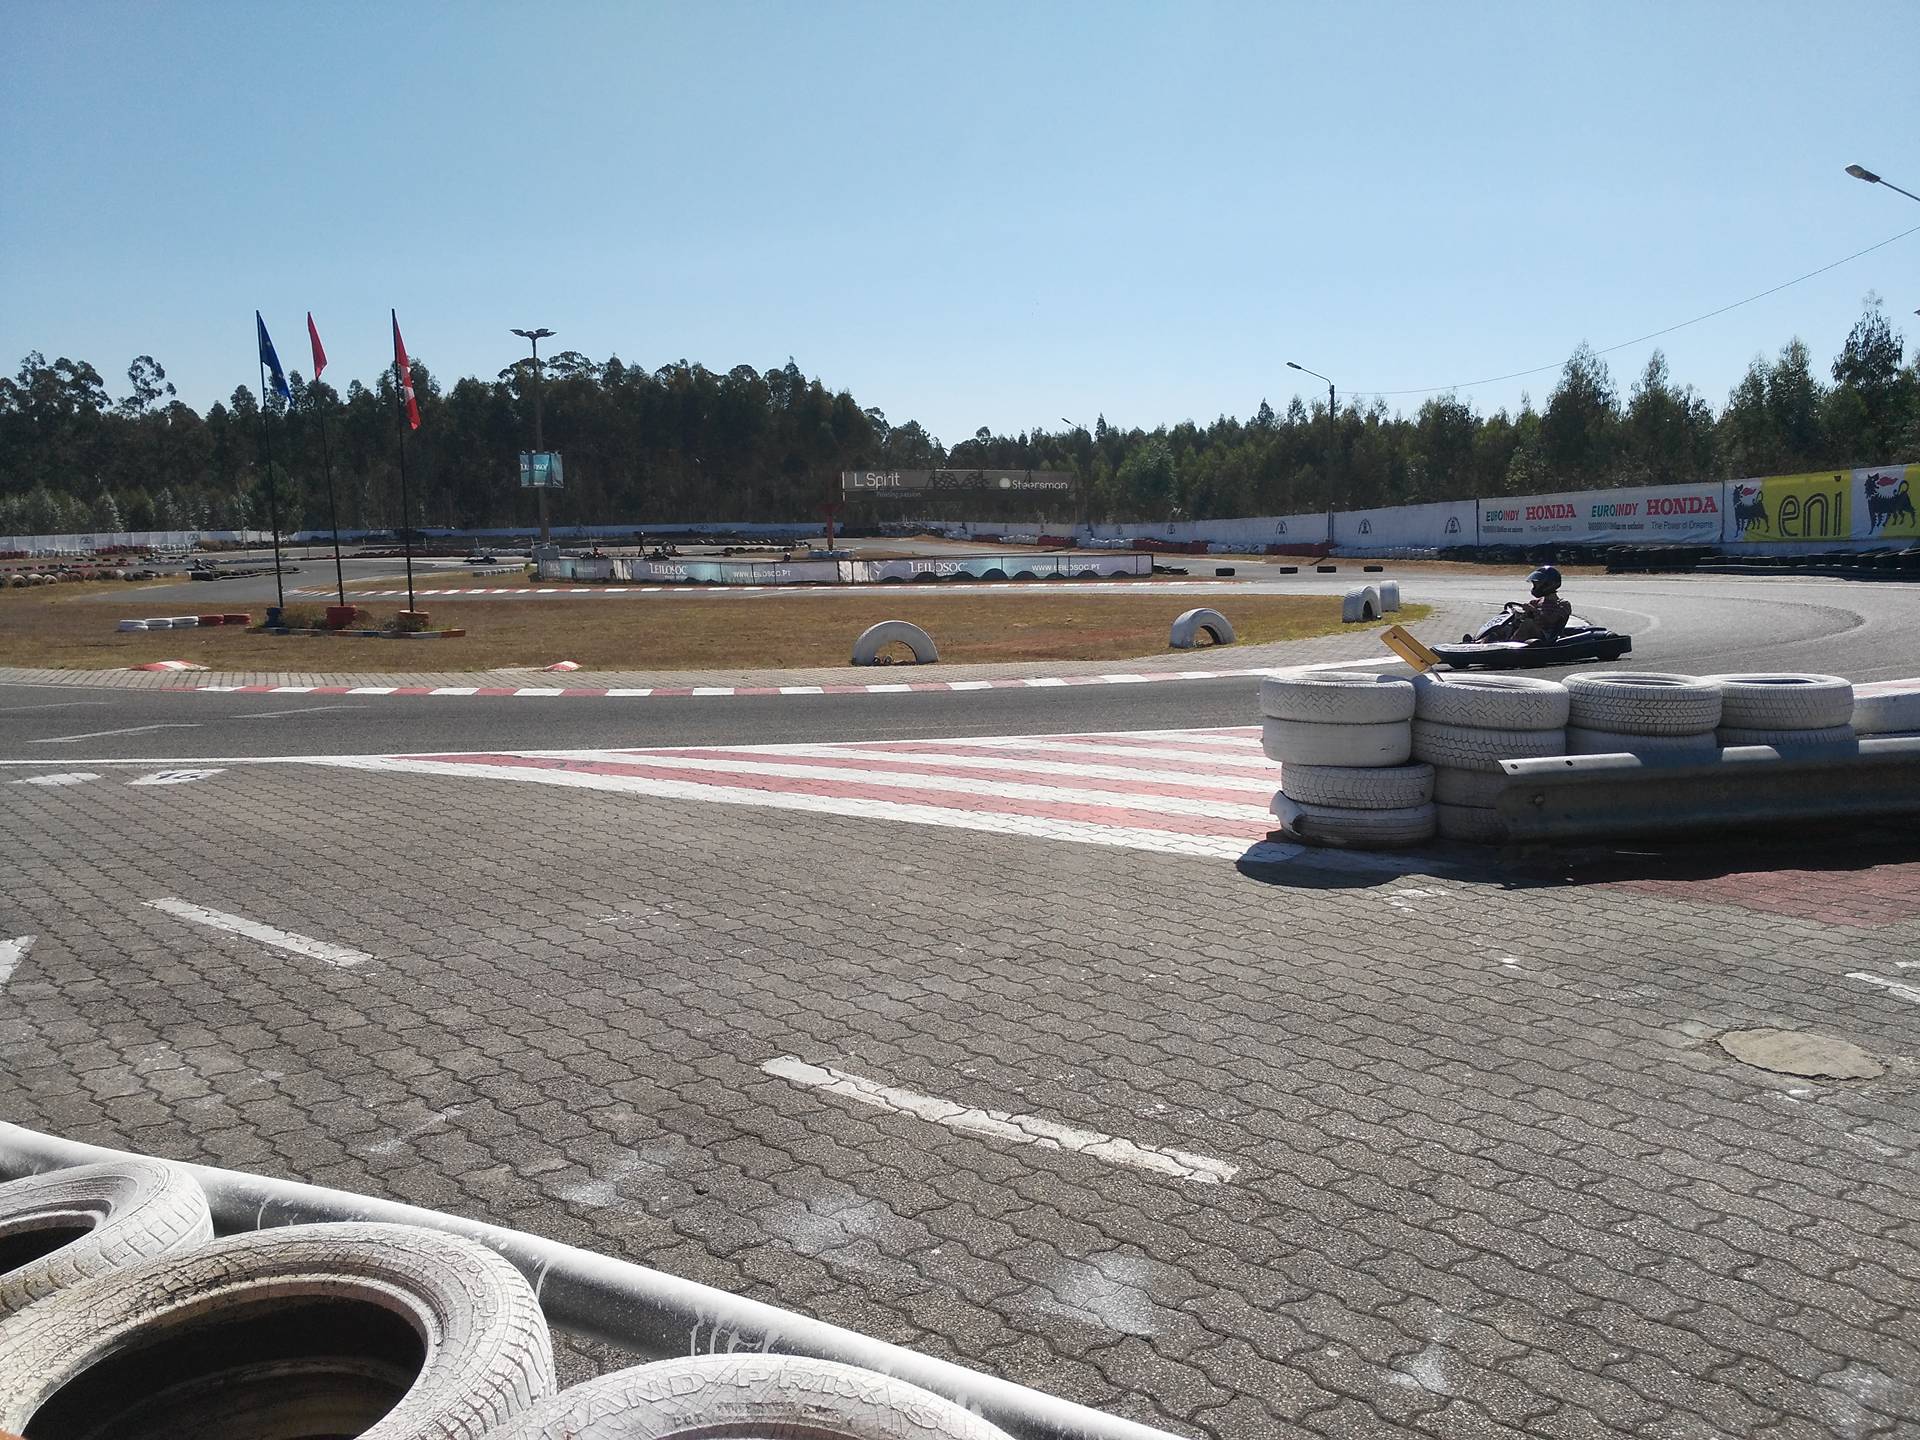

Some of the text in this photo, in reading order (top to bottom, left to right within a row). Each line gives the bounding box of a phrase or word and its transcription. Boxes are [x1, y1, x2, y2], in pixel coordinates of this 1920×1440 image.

[866, 472, 901, 490] Spirit
[1525, 503, 1577, 520] HONDA
[1591, 496, 1718, 518] EUROINDY HONDA
[1778, 475, 1843, 537] eni
[909, 561, 968, 573] LEILOSOC
